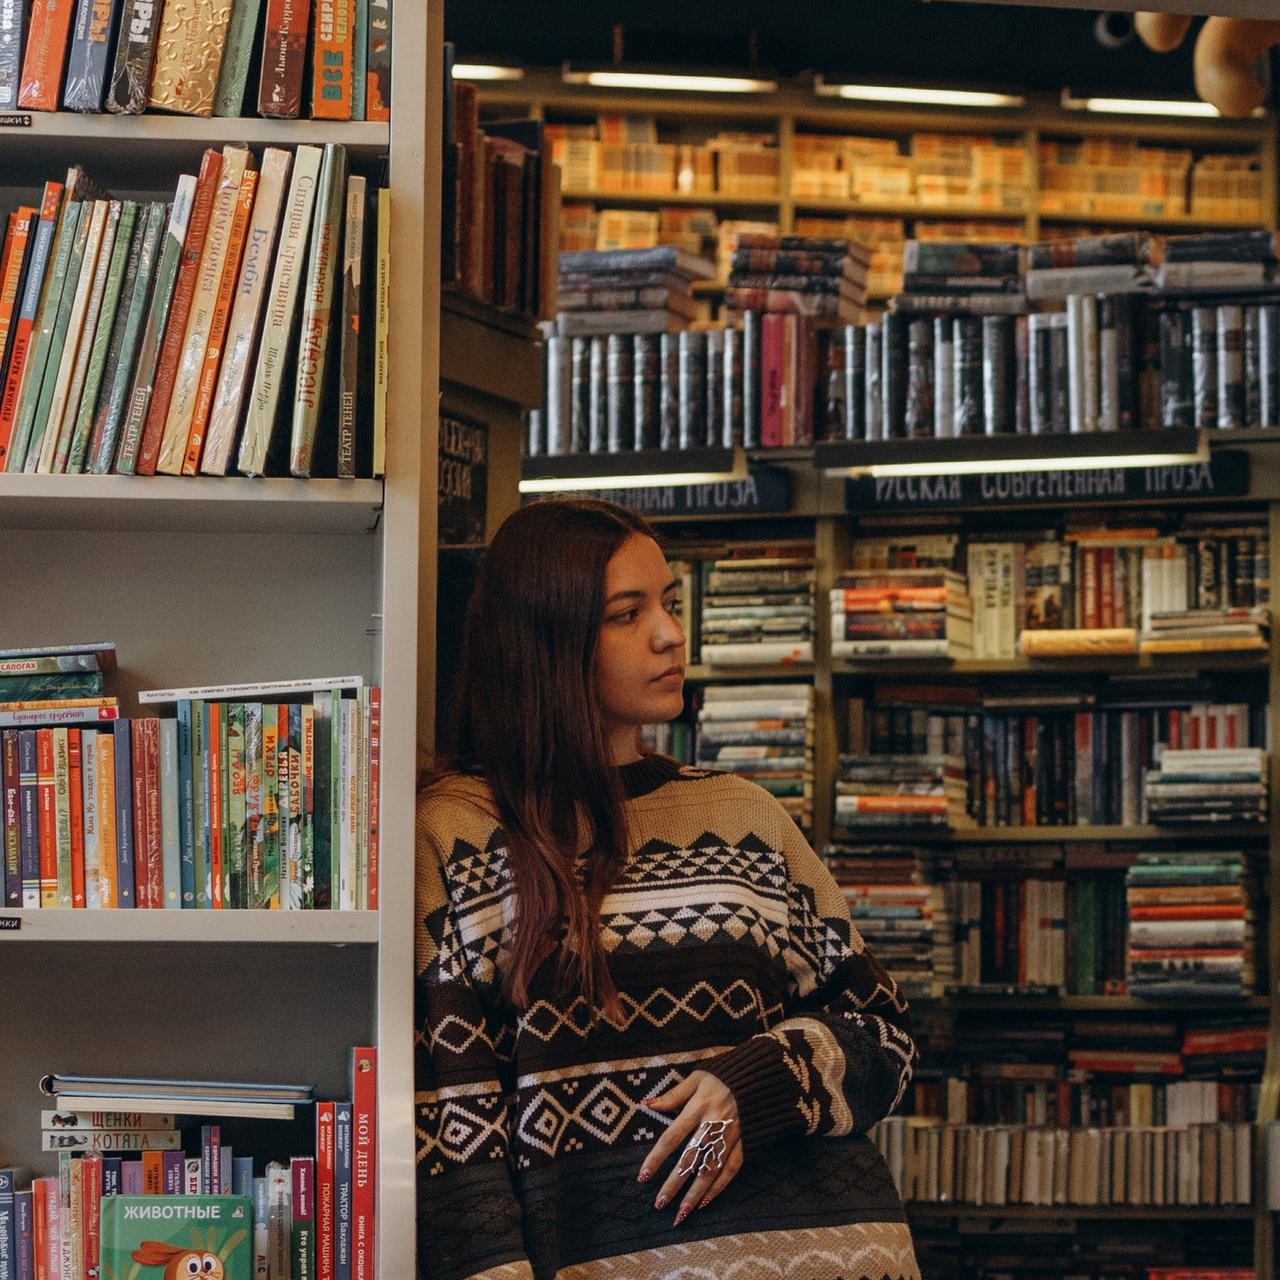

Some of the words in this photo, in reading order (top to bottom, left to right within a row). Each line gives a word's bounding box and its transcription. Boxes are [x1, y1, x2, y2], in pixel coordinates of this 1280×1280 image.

[275, 38, 289, 78] Льюис
[321, 50, 344, 100] ВСЕ
[287, 175, 313, 237] Спящая
[201, 178, 239, 293] Дюймовочка
[242, 228, 269, 296] Бемби
[271, 241, 297, 328] красавица
[131, 386, 147, 421] ТЕНЕЙ
[343, 391, 353, 428] ТЕНЕЙ
[123, 422, 141, 459] ТЕАТР
[342, 431, 352, 463] ТЕАТР
[1, 661, 37, 671] САПОГАХ
[265, 735, 275, 778] ОРЕХИ
[278, 751, 288, 809] ДЕРЕВЬЯ
[289, 753, 300, 816] БАБОЧКИ
[92, 1112, 142, 1128] ЩЕНКИ
[358, 1113, 372, 1144] МОЙ
[93, 1133, 150, 1149] КОТЯТА
[357, 1149, 368, 1187] ДЕНЬ
[124, 1205, 221, 1219] ЖИВОТНЫЕ
[321, 1182, 330, 1225] ПОЖАРНАЯ
[340, 1182, 348, 1219] ТРАКТОР
[321, 1230, 330, 1275] МАШИНА
